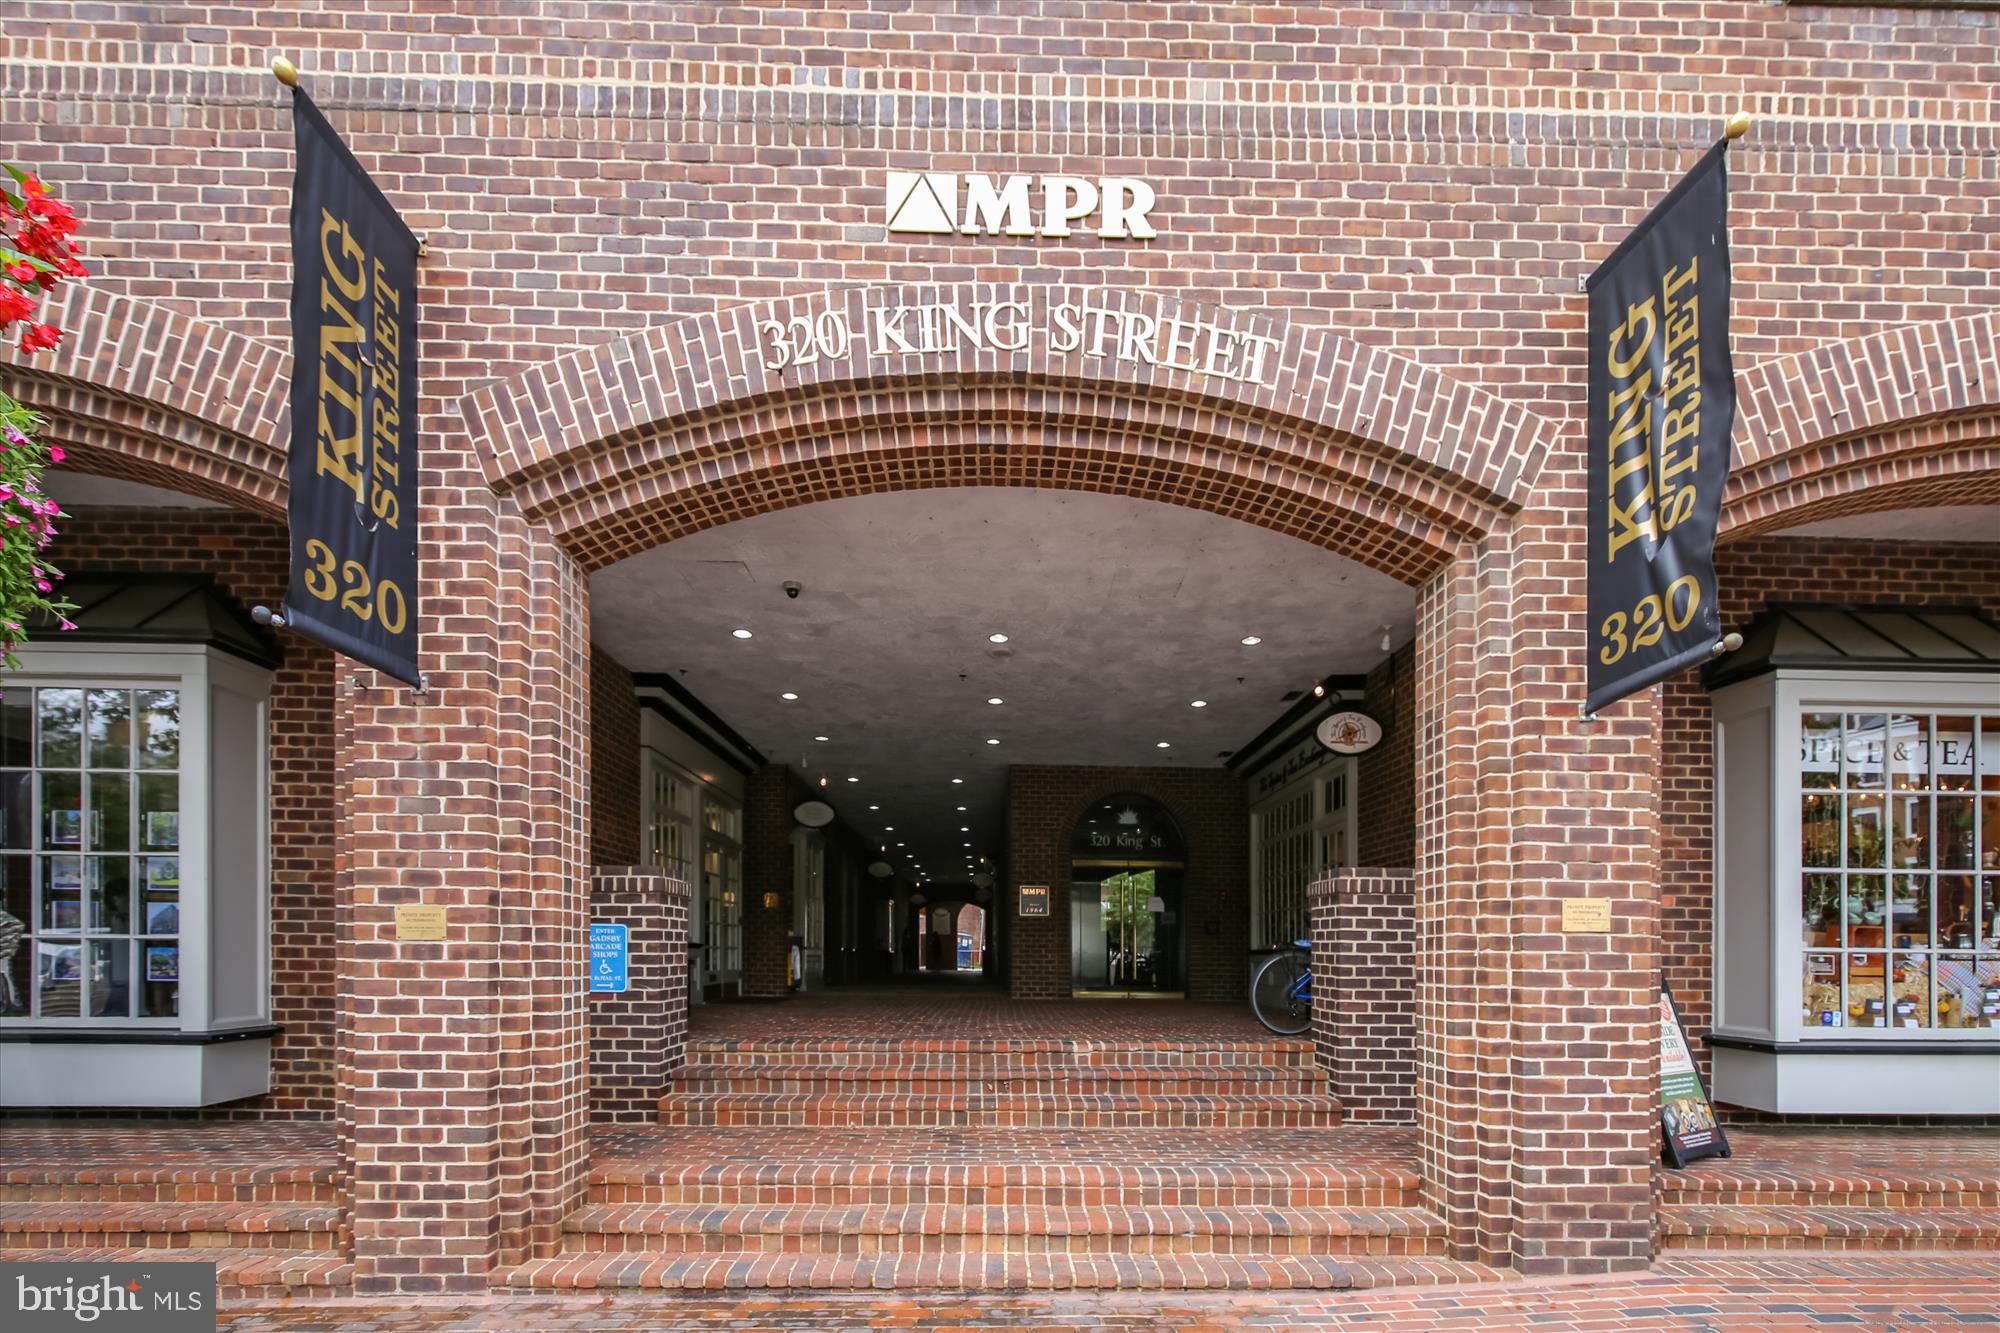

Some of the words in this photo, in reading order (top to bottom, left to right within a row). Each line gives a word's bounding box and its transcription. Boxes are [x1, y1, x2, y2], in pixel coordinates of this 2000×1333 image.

[961, 174, 1157, 238] MPR
[317, 206, 366, 504] KING
[763, 310, 847, 370] 320
[866, 301, 1031, 354] KING
[1050, 303, 1279, 384] STREET
[371, 257, 399, 530] STREET
[1608, 294, 1658, 563] KING
[1660, 256, 1702, 533] STREET
[304, 538, 407, 635] 320
[1600, 573, 1700, 665] 320
[1893, 742, 1912, 761] &
[1919, 740, 1985, 765] TEA
[1090, 835, 1111, 847] 320
[1116, 835, 1143, 850] King
